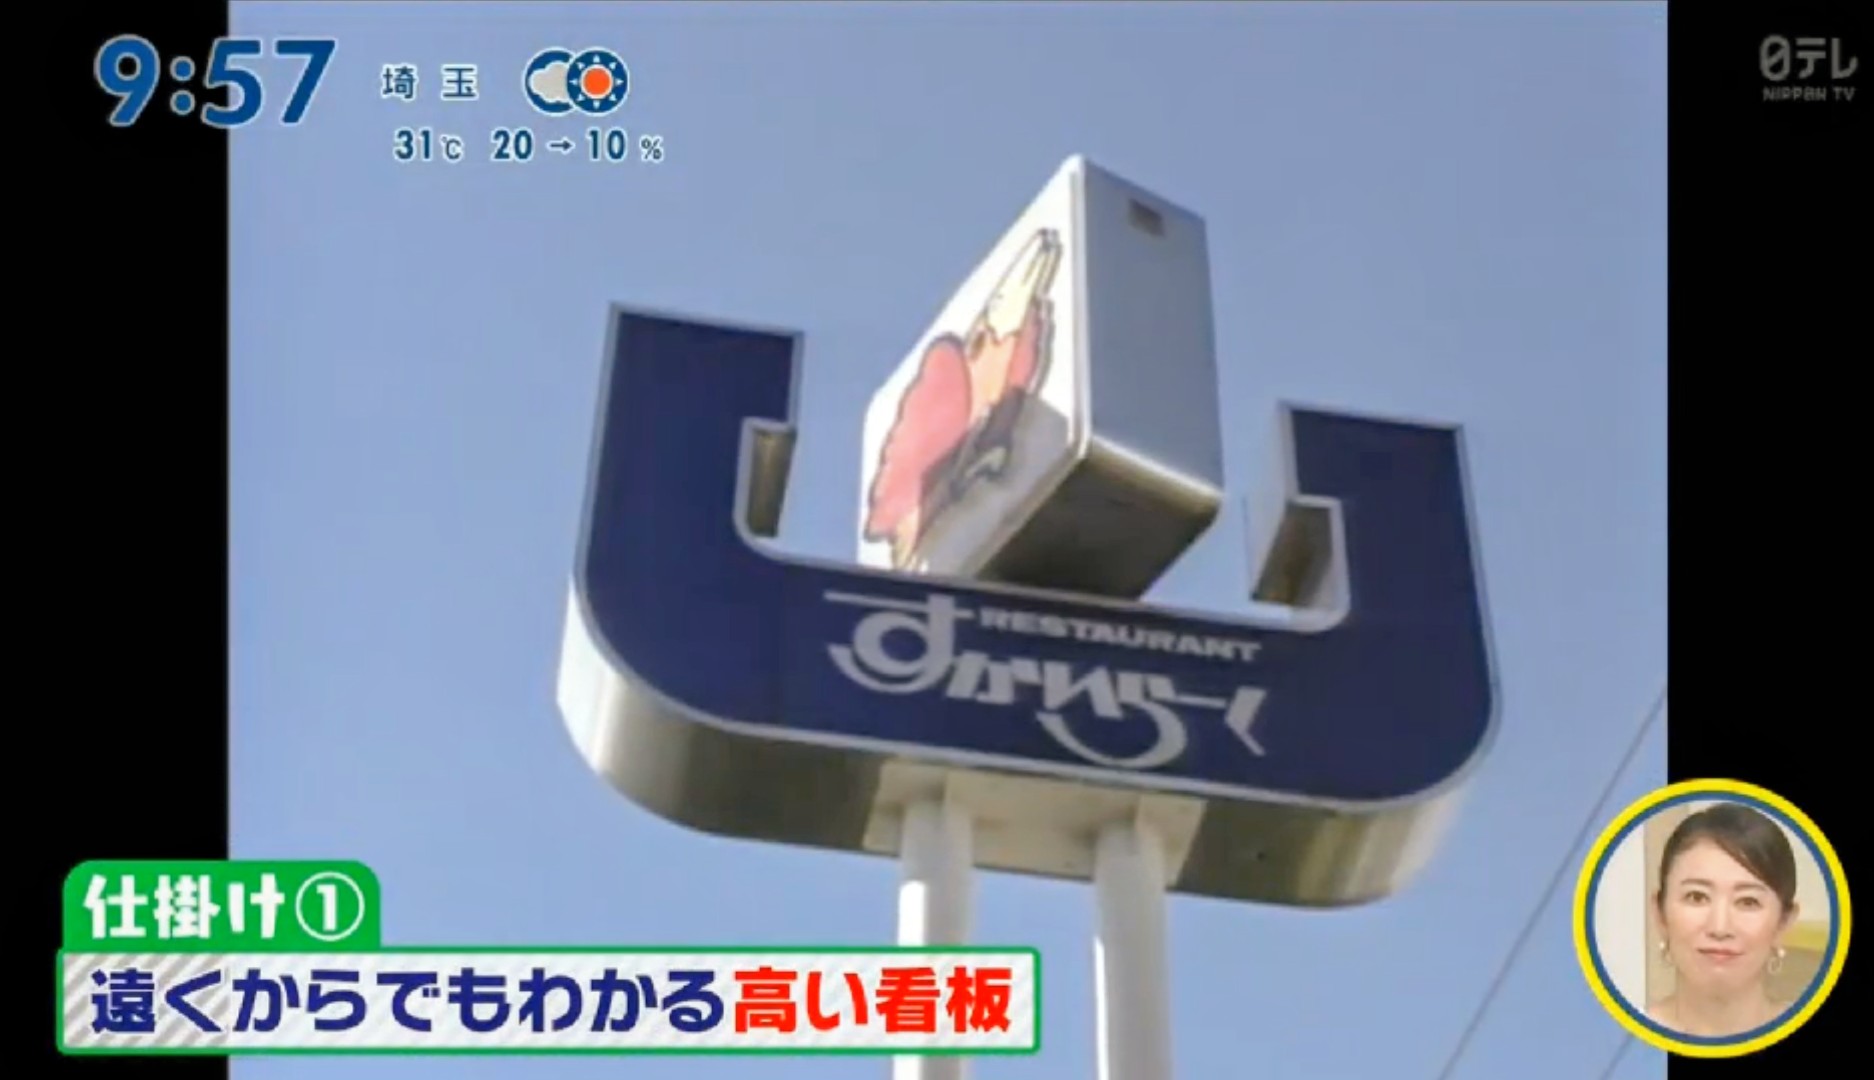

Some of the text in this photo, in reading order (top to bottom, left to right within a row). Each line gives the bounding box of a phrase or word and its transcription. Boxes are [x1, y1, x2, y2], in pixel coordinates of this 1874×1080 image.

[823, 590, 1267, 770] すかいらーく
[979, 606, 1262, 662] RESTAURANT
